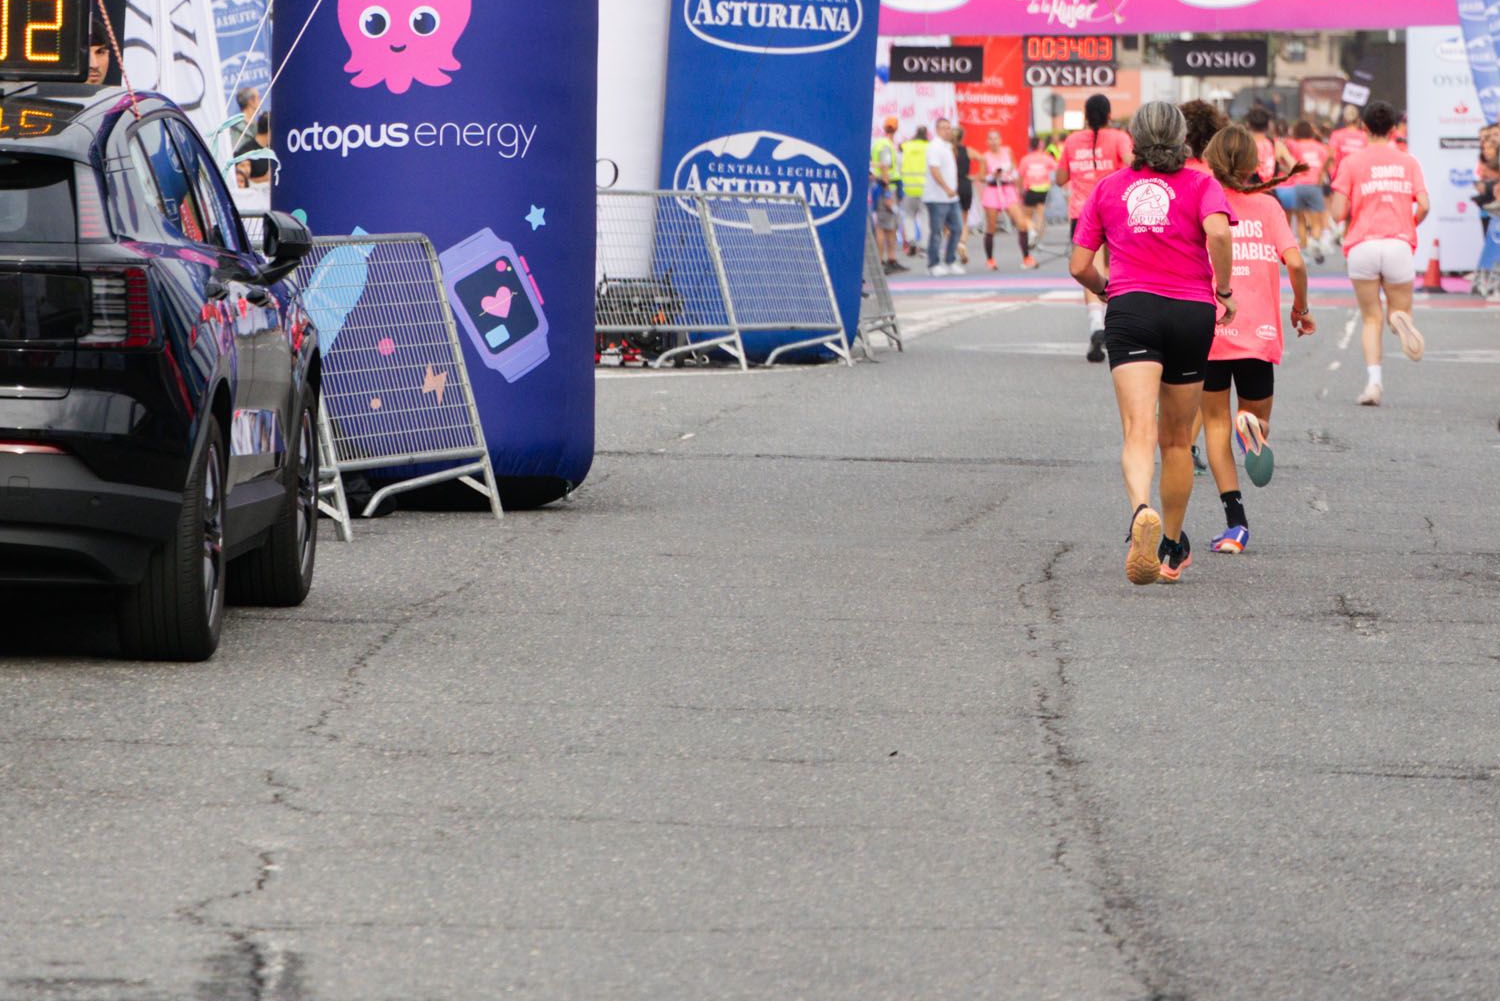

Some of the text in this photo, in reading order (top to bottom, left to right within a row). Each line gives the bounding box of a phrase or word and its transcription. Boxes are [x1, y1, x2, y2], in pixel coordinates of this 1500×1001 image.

[903, 57, 971, 73] OYSHO
[1186, 52, 1256, 68] OYSHO
[1026, 66, 1114, 86] OYSHO
[287, 121, 537, 159] octopus energy
[708, 162, 838, 179] CENTRAL LECHERA
[1232, 220, 1263, 239] MOS
[1232, 242, 1278, 263] RABLES
